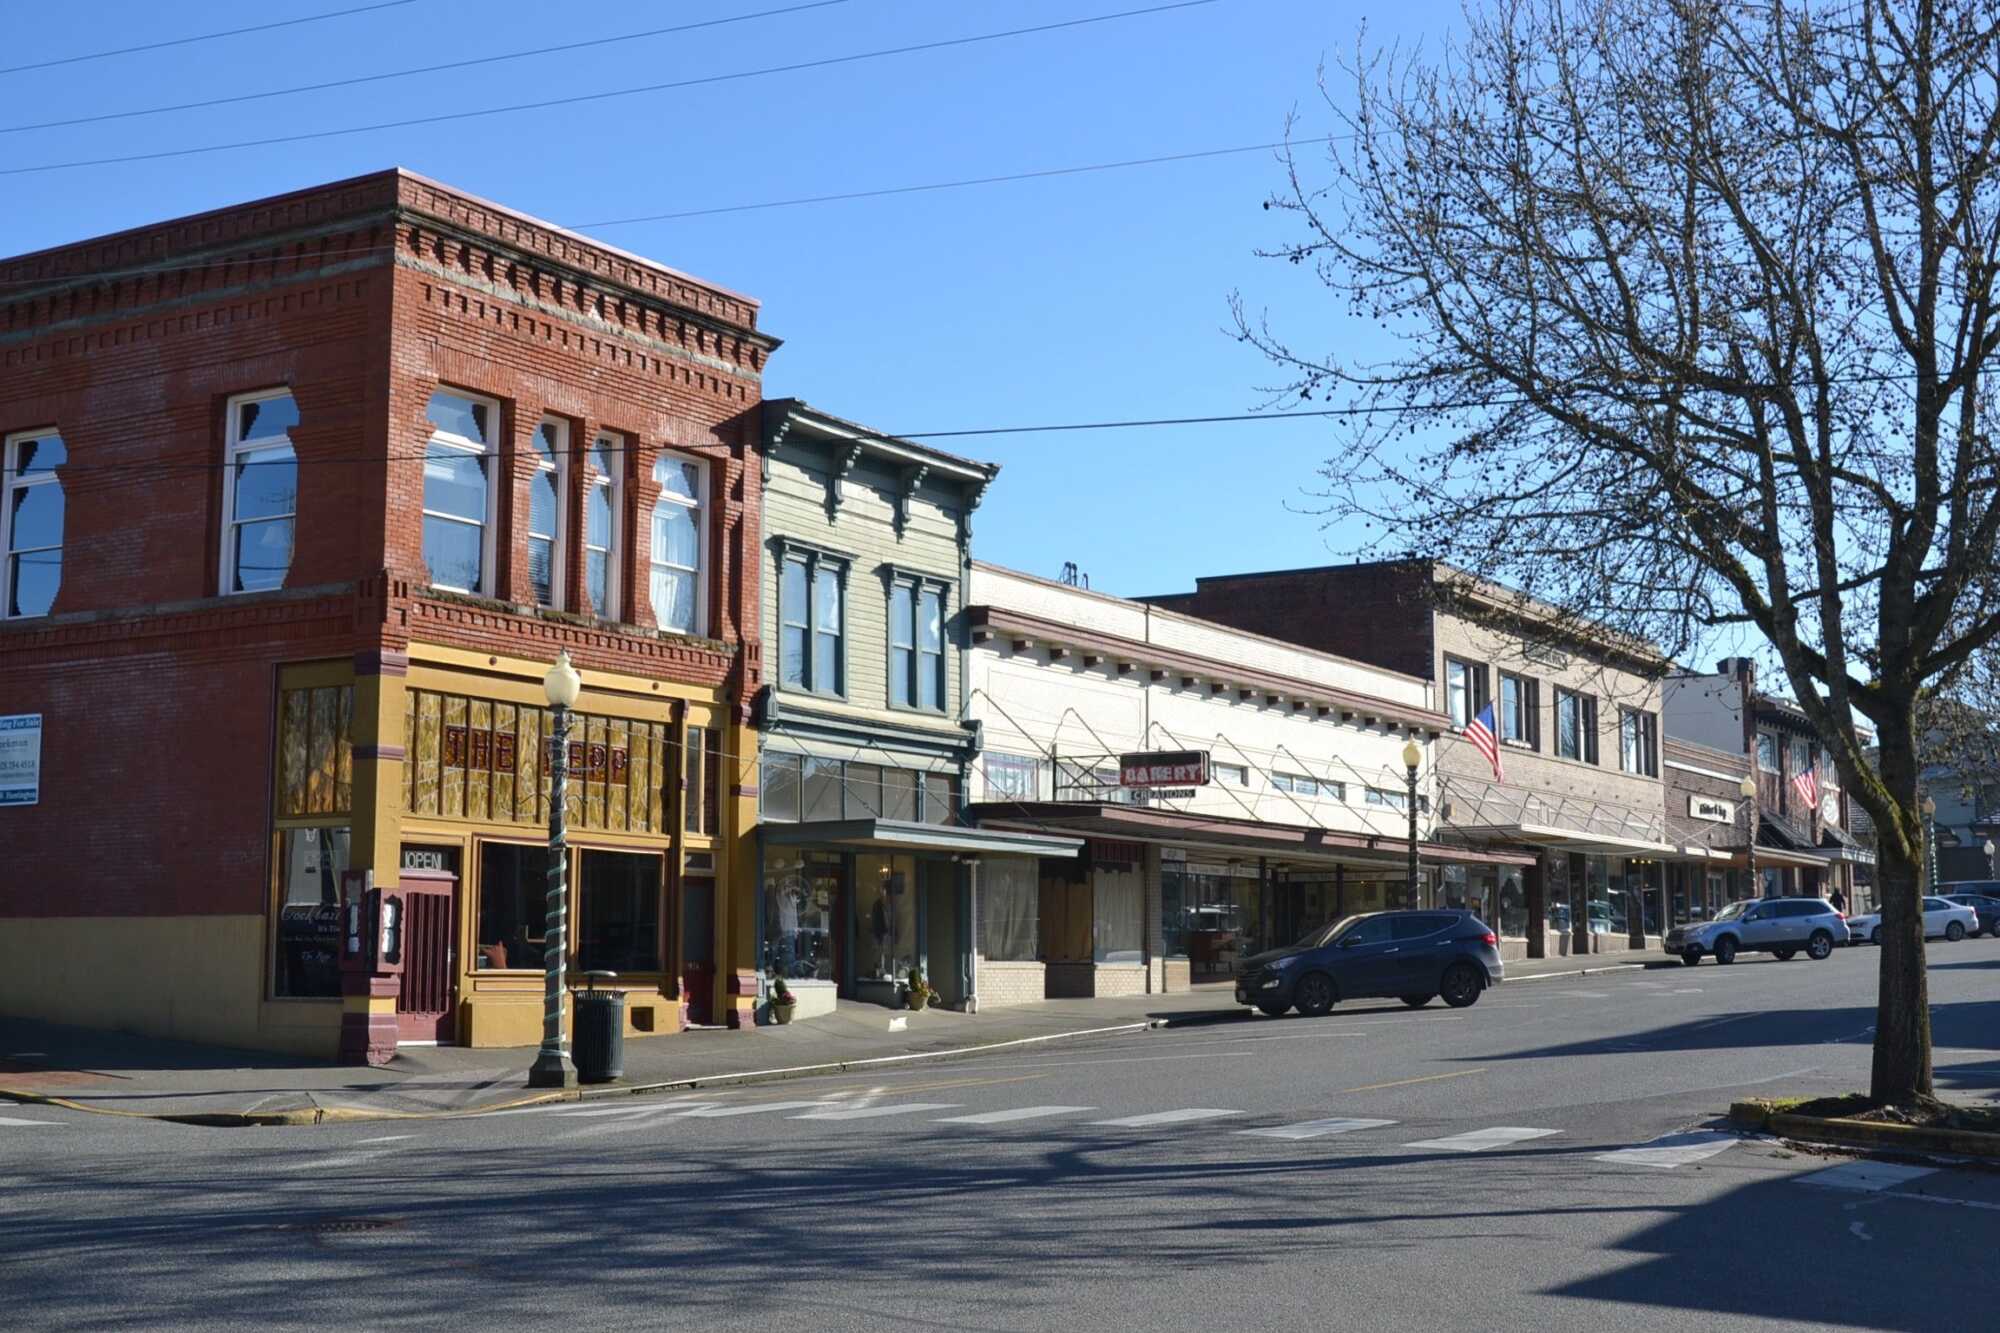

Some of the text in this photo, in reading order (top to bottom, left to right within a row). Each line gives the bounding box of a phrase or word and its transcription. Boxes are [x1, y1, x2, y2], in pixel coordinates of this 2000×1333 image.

[448, 730, 513, 769] THE
[1125, 764, 1199, 783] BAKERY
[1134, 789, 1193, 800] CREATIONS
[406, 852, 441, 869] OPEN
